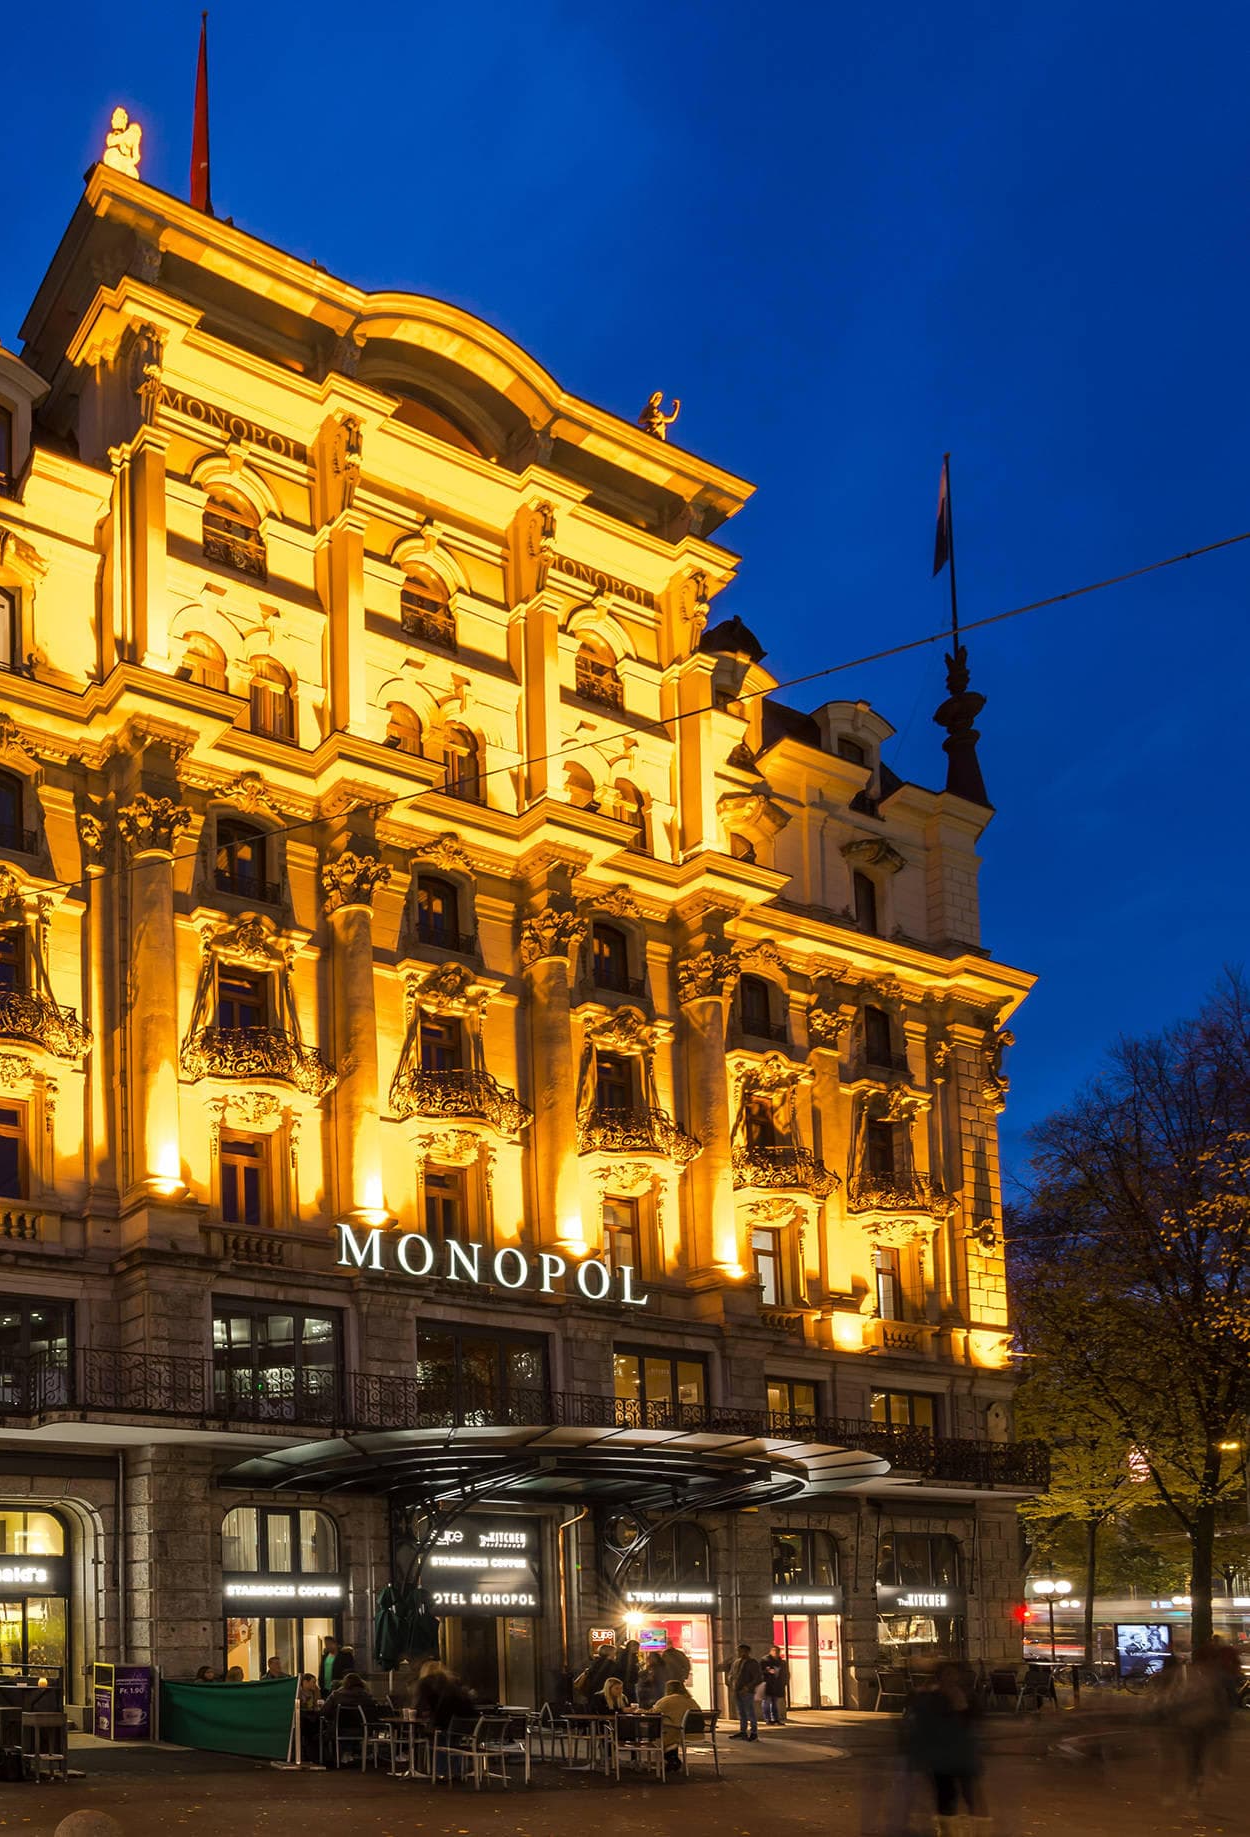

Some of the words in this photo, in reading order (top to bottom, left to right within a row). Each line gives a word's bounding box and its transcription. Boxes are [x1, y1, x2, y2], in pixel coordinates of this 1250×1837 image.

[160, 385, 306, 463] MONOPOL
[335, 1223, 649, 1305] MONOPOL
[489, 1531, 526, 1544] KITCHEN
[470, 1592, 536, 1606] MONOPOL
[655, 1592, 678, 1602] LAST
[907, 1593, 947, 1607] KITCHEN
